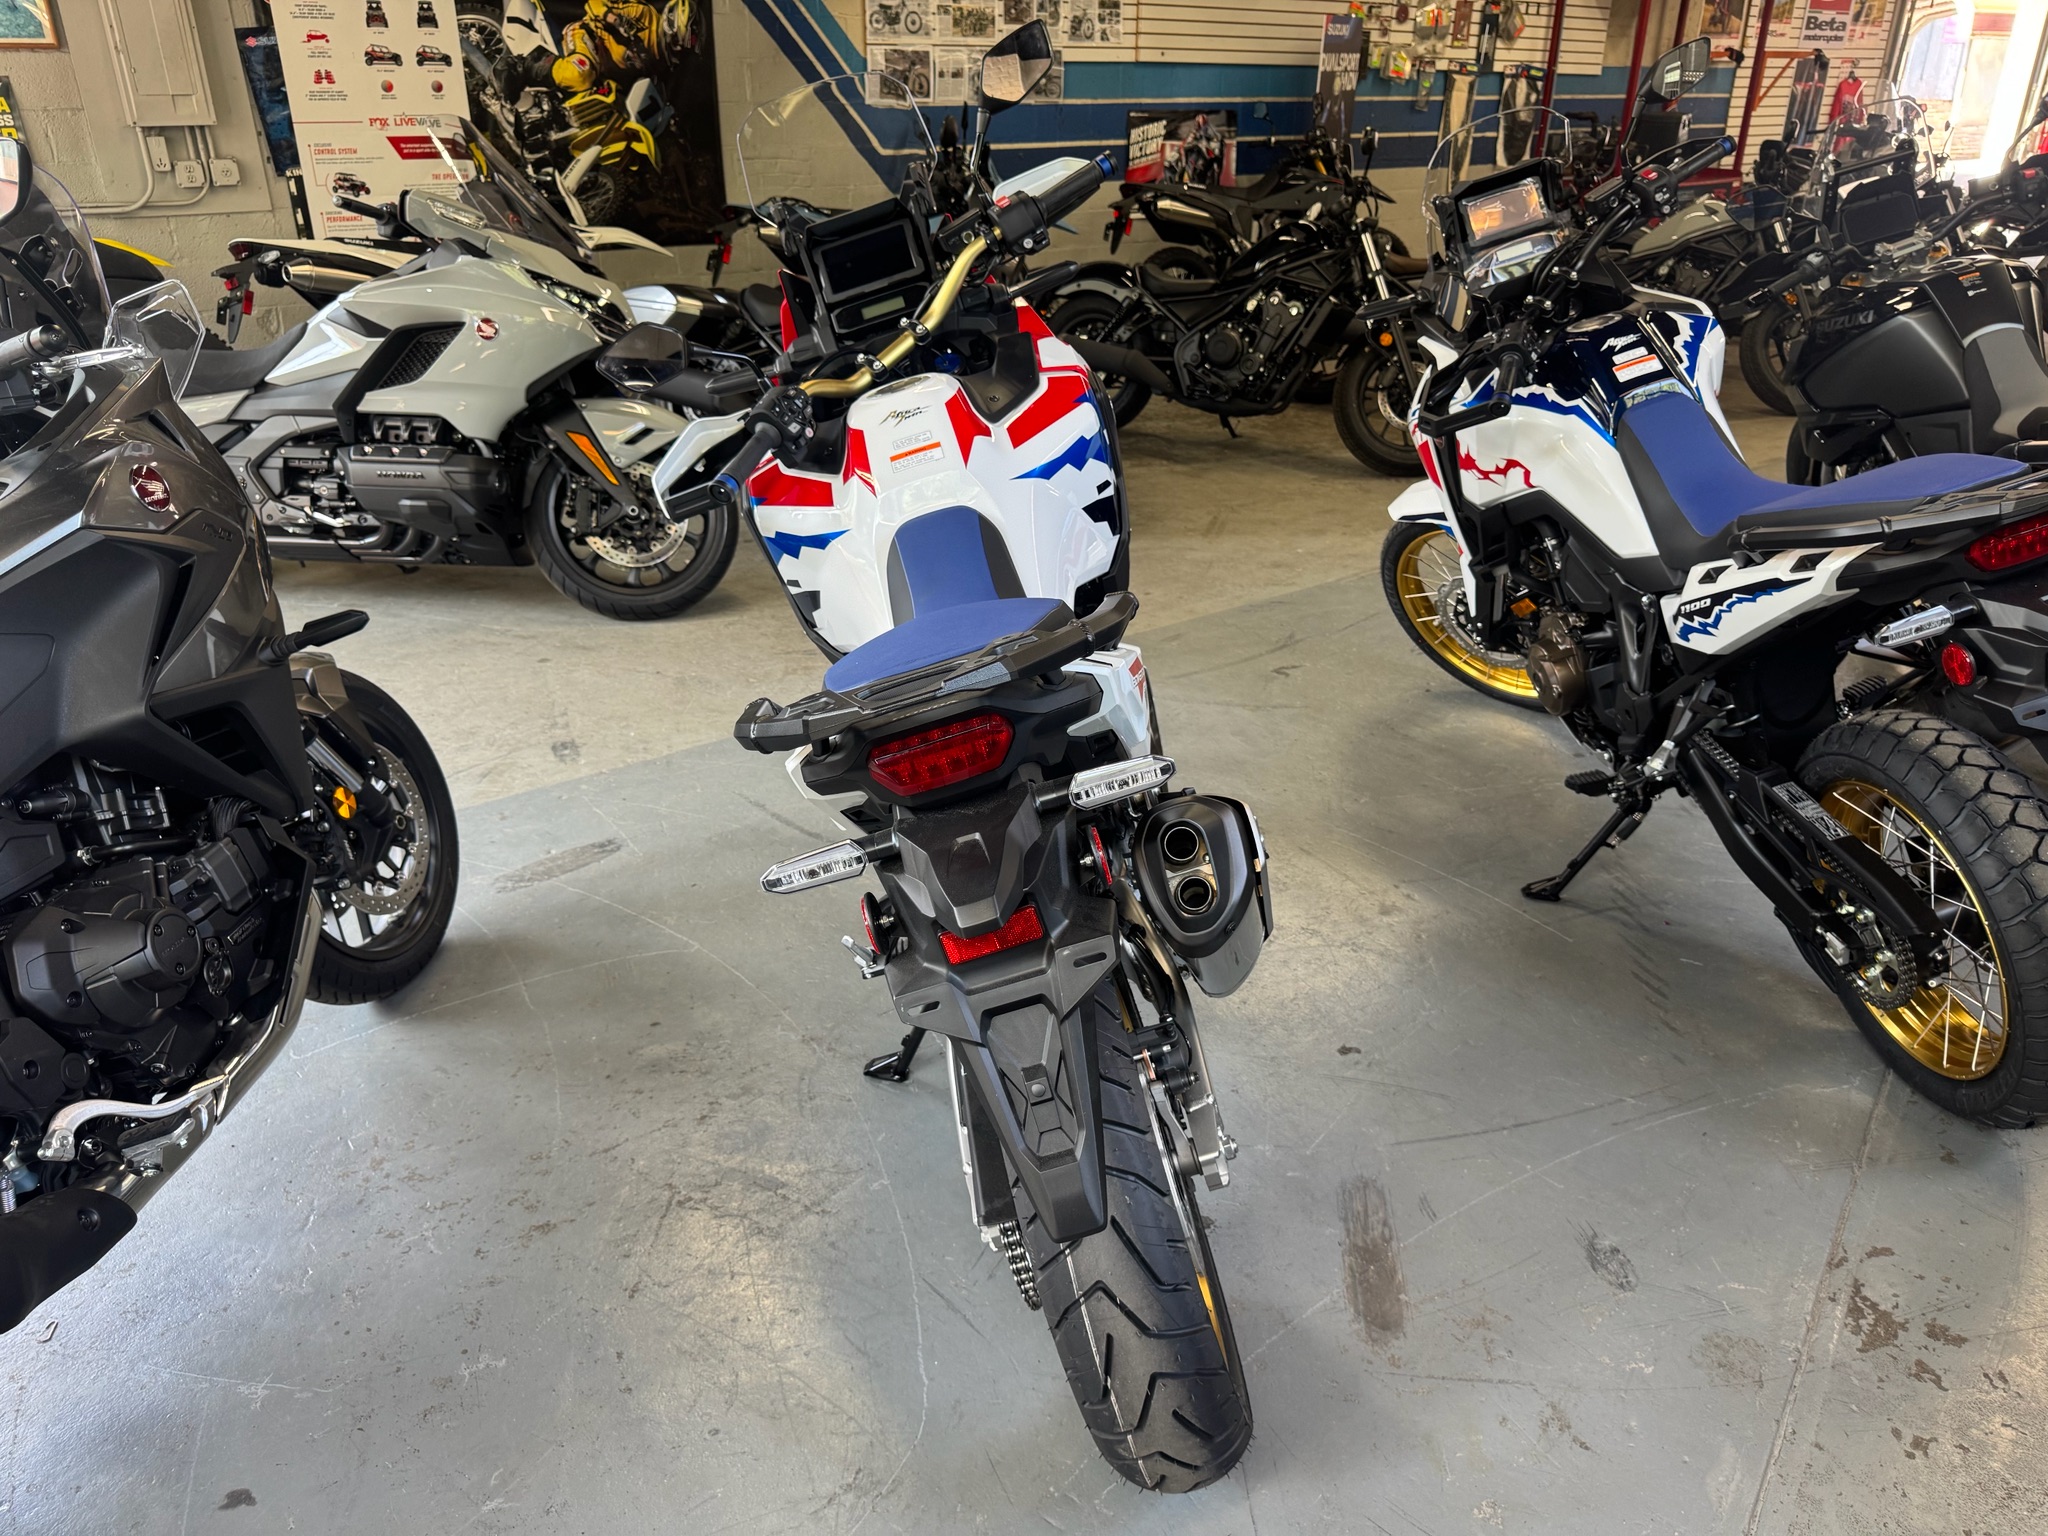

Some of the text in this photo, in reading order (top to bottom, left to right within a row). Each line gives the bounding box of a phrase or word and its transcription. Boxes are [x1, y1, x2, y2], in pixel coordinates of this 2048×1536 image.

[1805, 15, 1848, 32] Beta
[369, 117, 390, 127] FOX
[376, 470, 427, 480] HONDA
[1680, 598, 1711, 614] 1100
